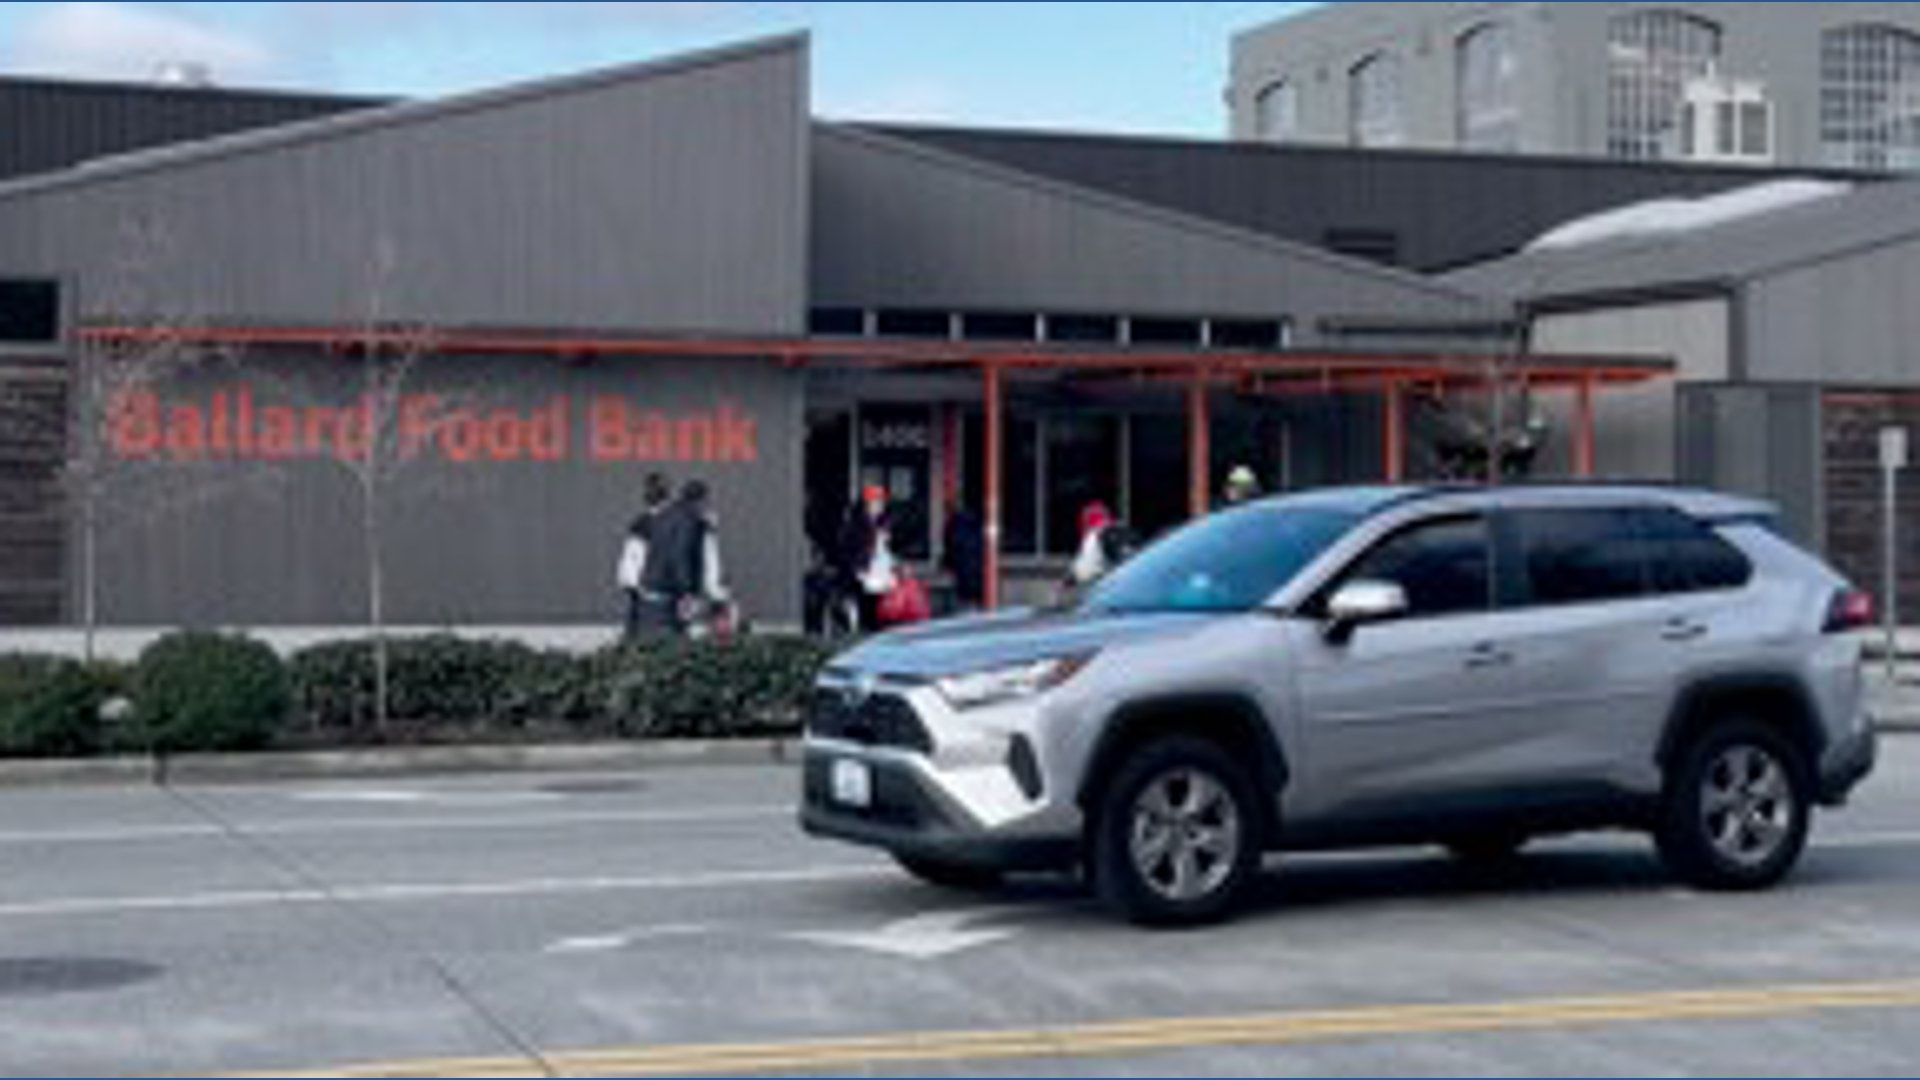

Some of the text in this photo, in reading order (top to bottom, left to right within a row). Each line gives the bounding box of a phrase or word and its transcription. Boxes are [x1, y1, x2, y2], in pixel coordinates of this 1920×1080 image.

[112, 386, 758, 462] Ballard Food Bank
